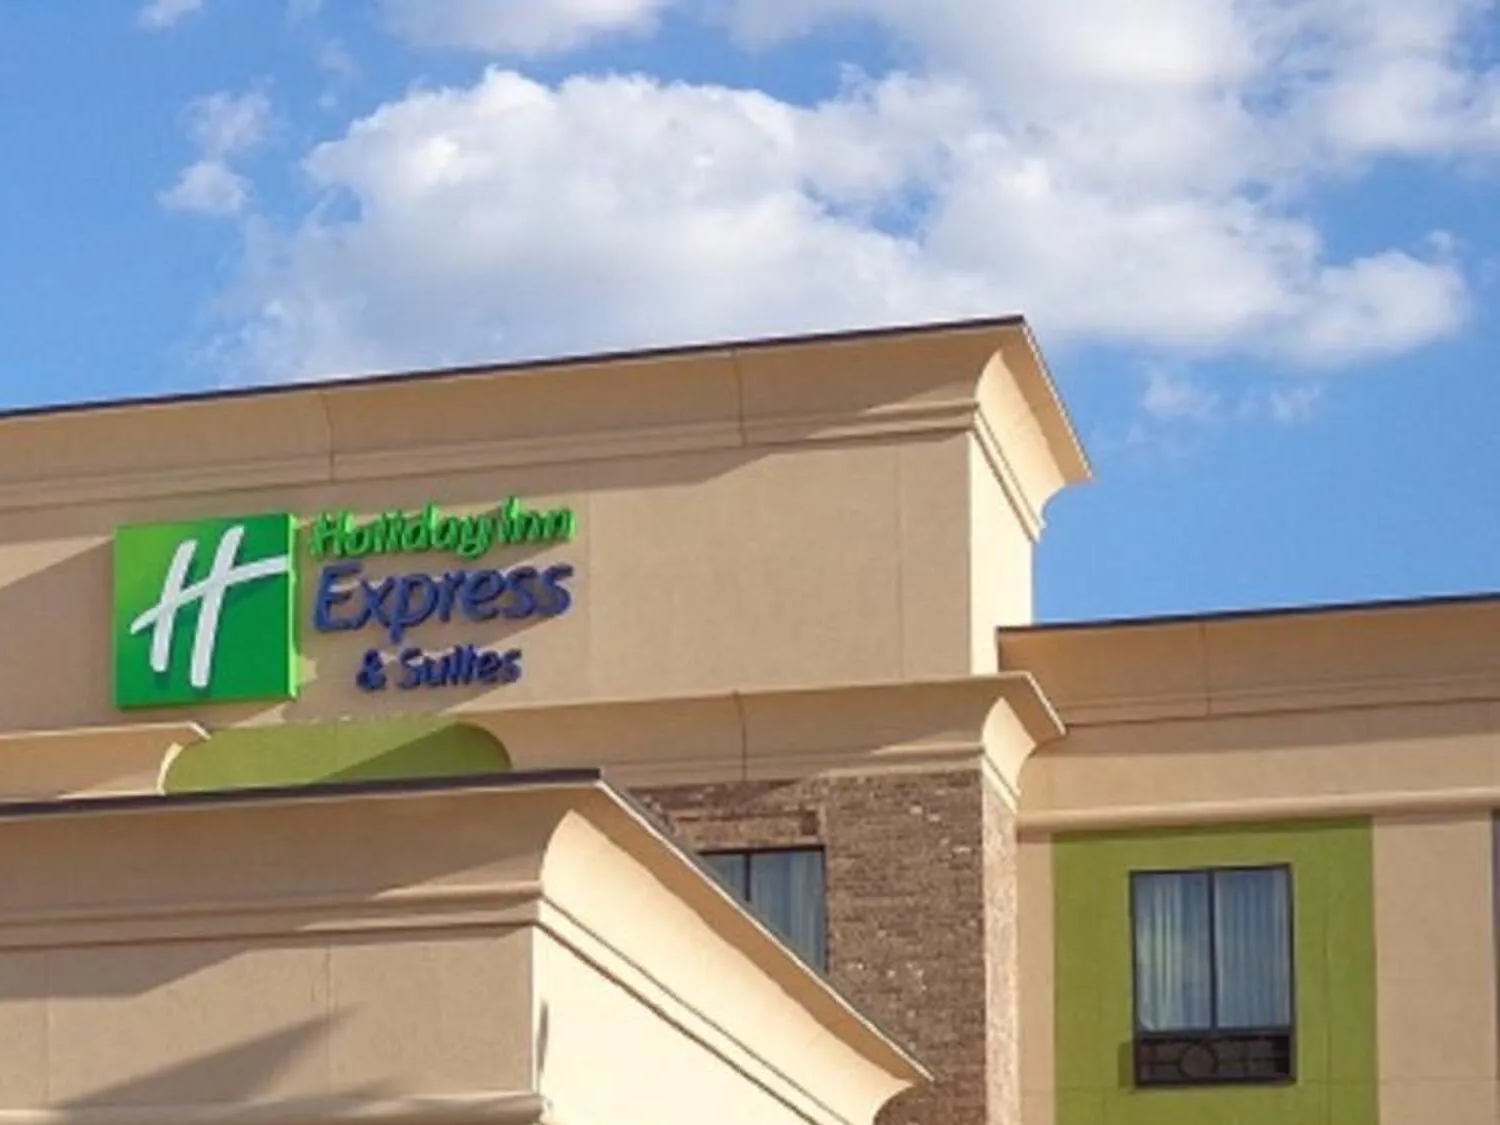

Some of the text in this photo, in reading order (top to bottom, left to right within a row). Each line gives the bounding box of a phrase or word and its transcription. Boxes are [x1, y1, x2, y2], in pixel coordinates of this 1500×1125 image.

[311, 496, 576, 560] Holiday Inn
[314, 560, 574, 644] Express
[356, 645, 522, 690] & Suites
